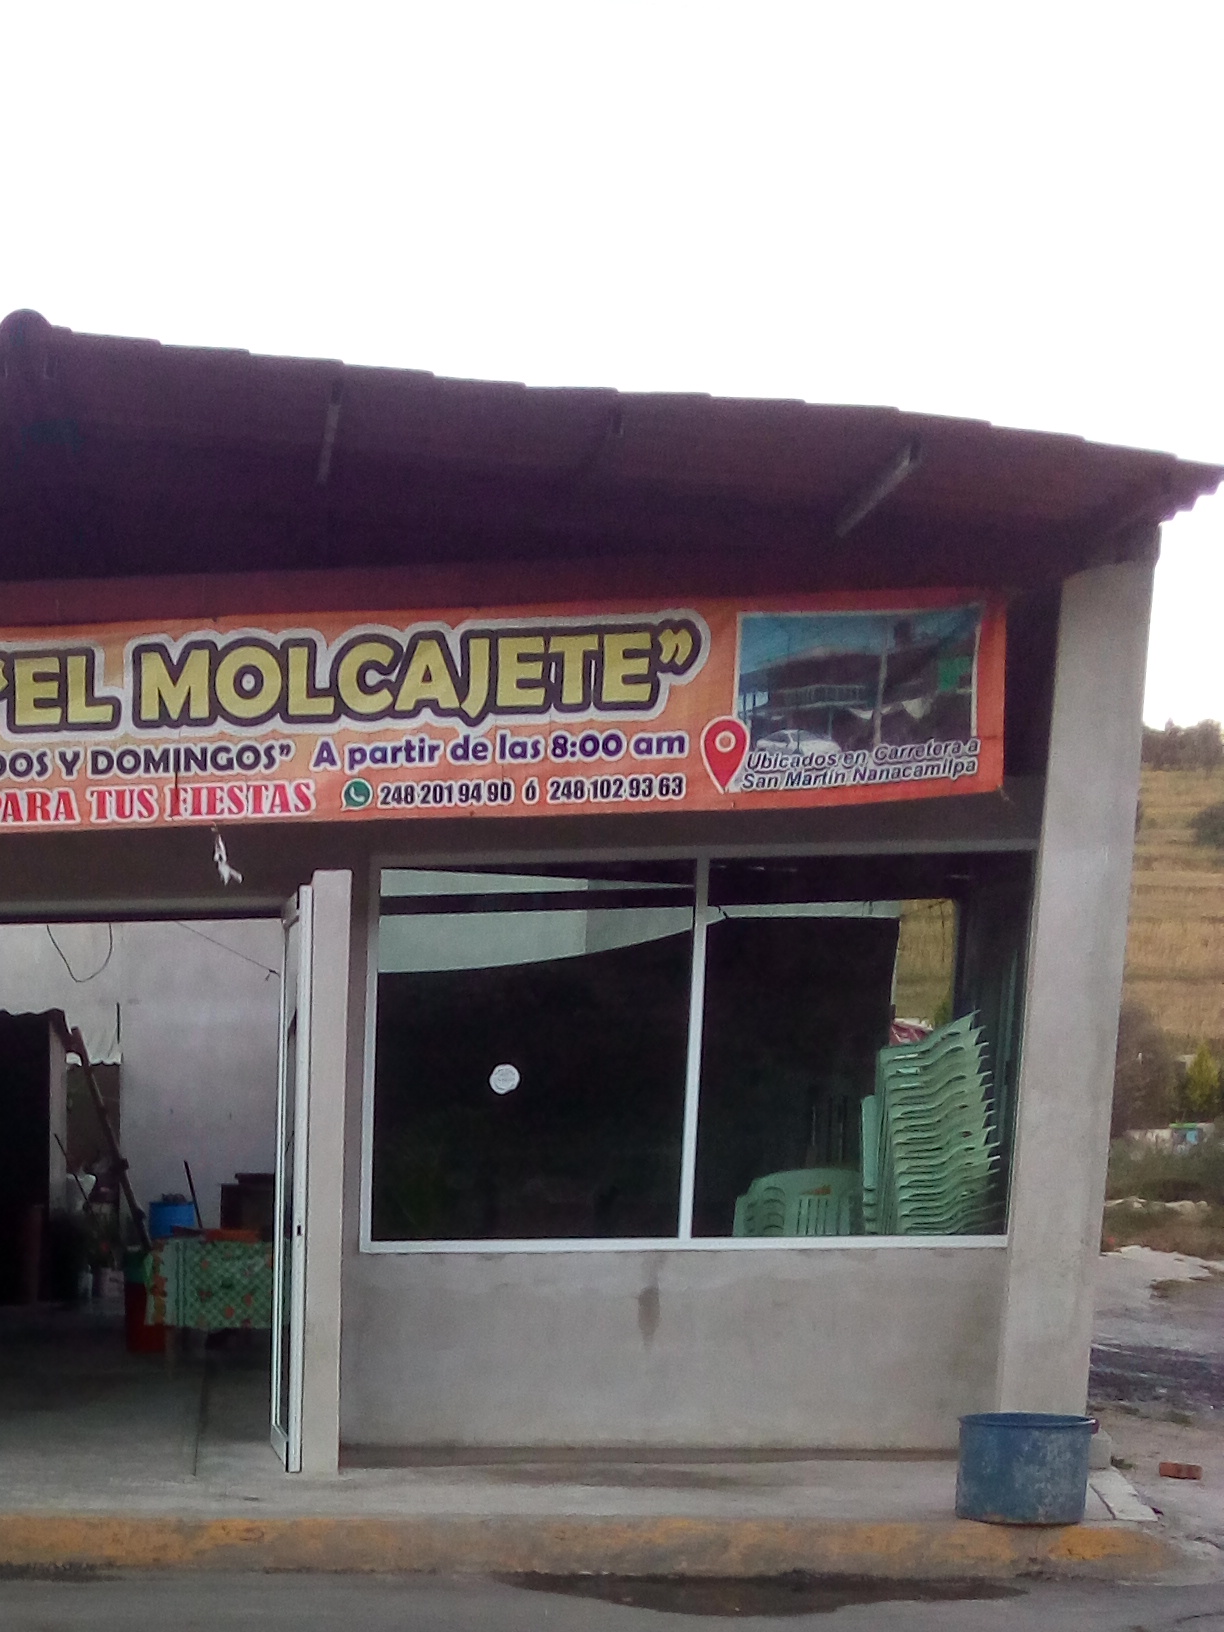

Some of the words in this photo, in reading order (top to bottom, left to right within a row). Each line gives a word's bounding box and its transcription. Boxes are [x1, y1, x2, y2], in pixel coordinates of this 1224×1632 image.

[56, 751, 81, 776] Y
[313, 741, 339, 767] A
[347, 734, 440, 772] partir
[450, 735, 489, 762] de
[498, 734, 541, 760] las
[551, 734, 626, 759] 8:00
[633, 734, 686, 756] am
[747, 751, 837, 771] Ubicados
[841, 751, 867, 765] en
[875, 740, 962, 760] Carretera
[967, 740, 978, 753] a
[742, 772, 779, 790] San
[785, 769, 846, 788] Martín
[852, 758, 977, 782] Nanacamilpa
[90, 787, 156, 822] TUS
[168, 781, 313, 818] FIESTAS
[380, 782, 419, 806] 248
[419, 781, 453, 805] 201
[458, 780, 482, 803] 94
[487, 780, 512, 802] 90
[525, 779, 537, 801] ó
[550, 778, 585, 801] 248
[591, 778, 625, 800] 102
[629, 777, 653, 799] 93
[659, 776, 684, 798] 63
